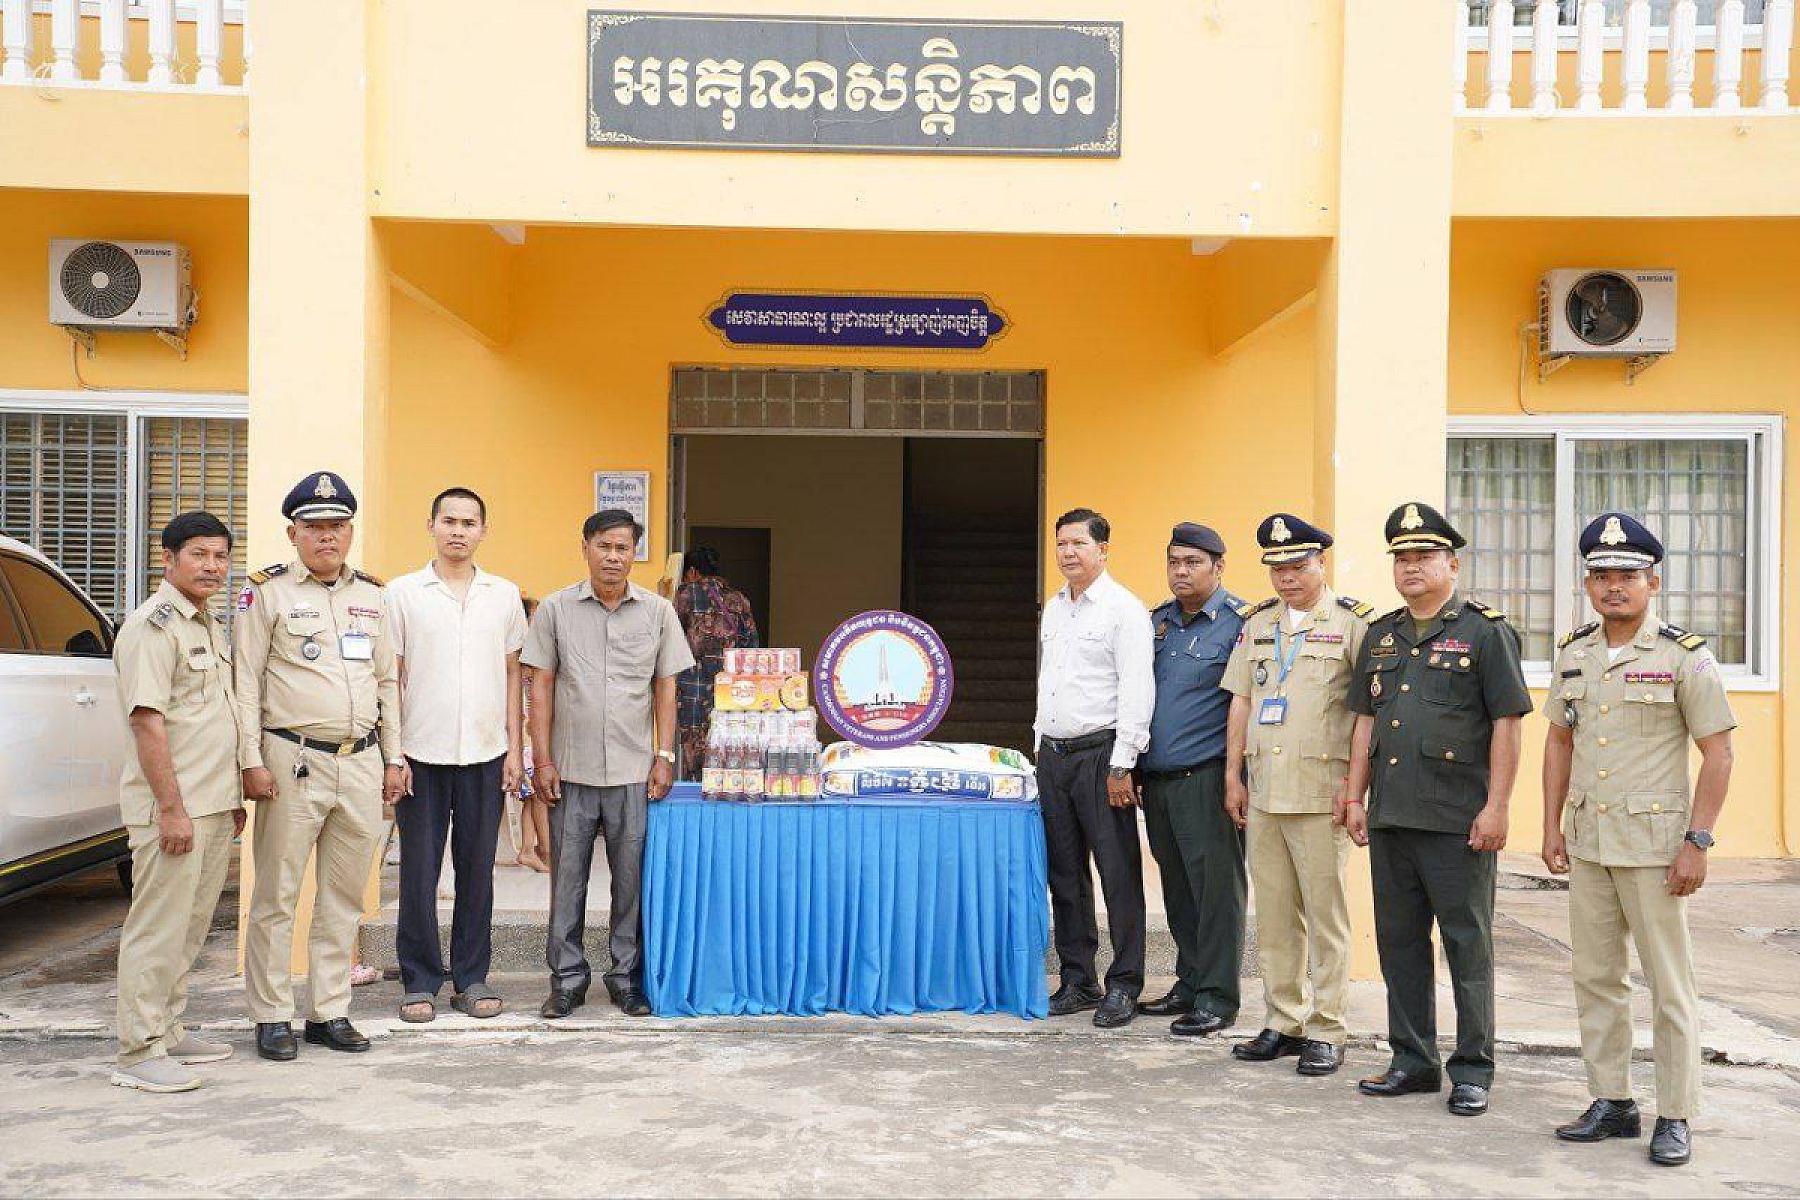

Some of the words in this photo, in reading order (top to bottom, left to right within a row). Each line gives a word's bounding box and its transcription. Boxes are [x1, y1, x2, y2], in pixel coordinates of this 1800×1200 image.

[613, 37, 1096, 136] អរគុណសន្តិភាព
[134, 248, 172, 256] SAMSUNG
